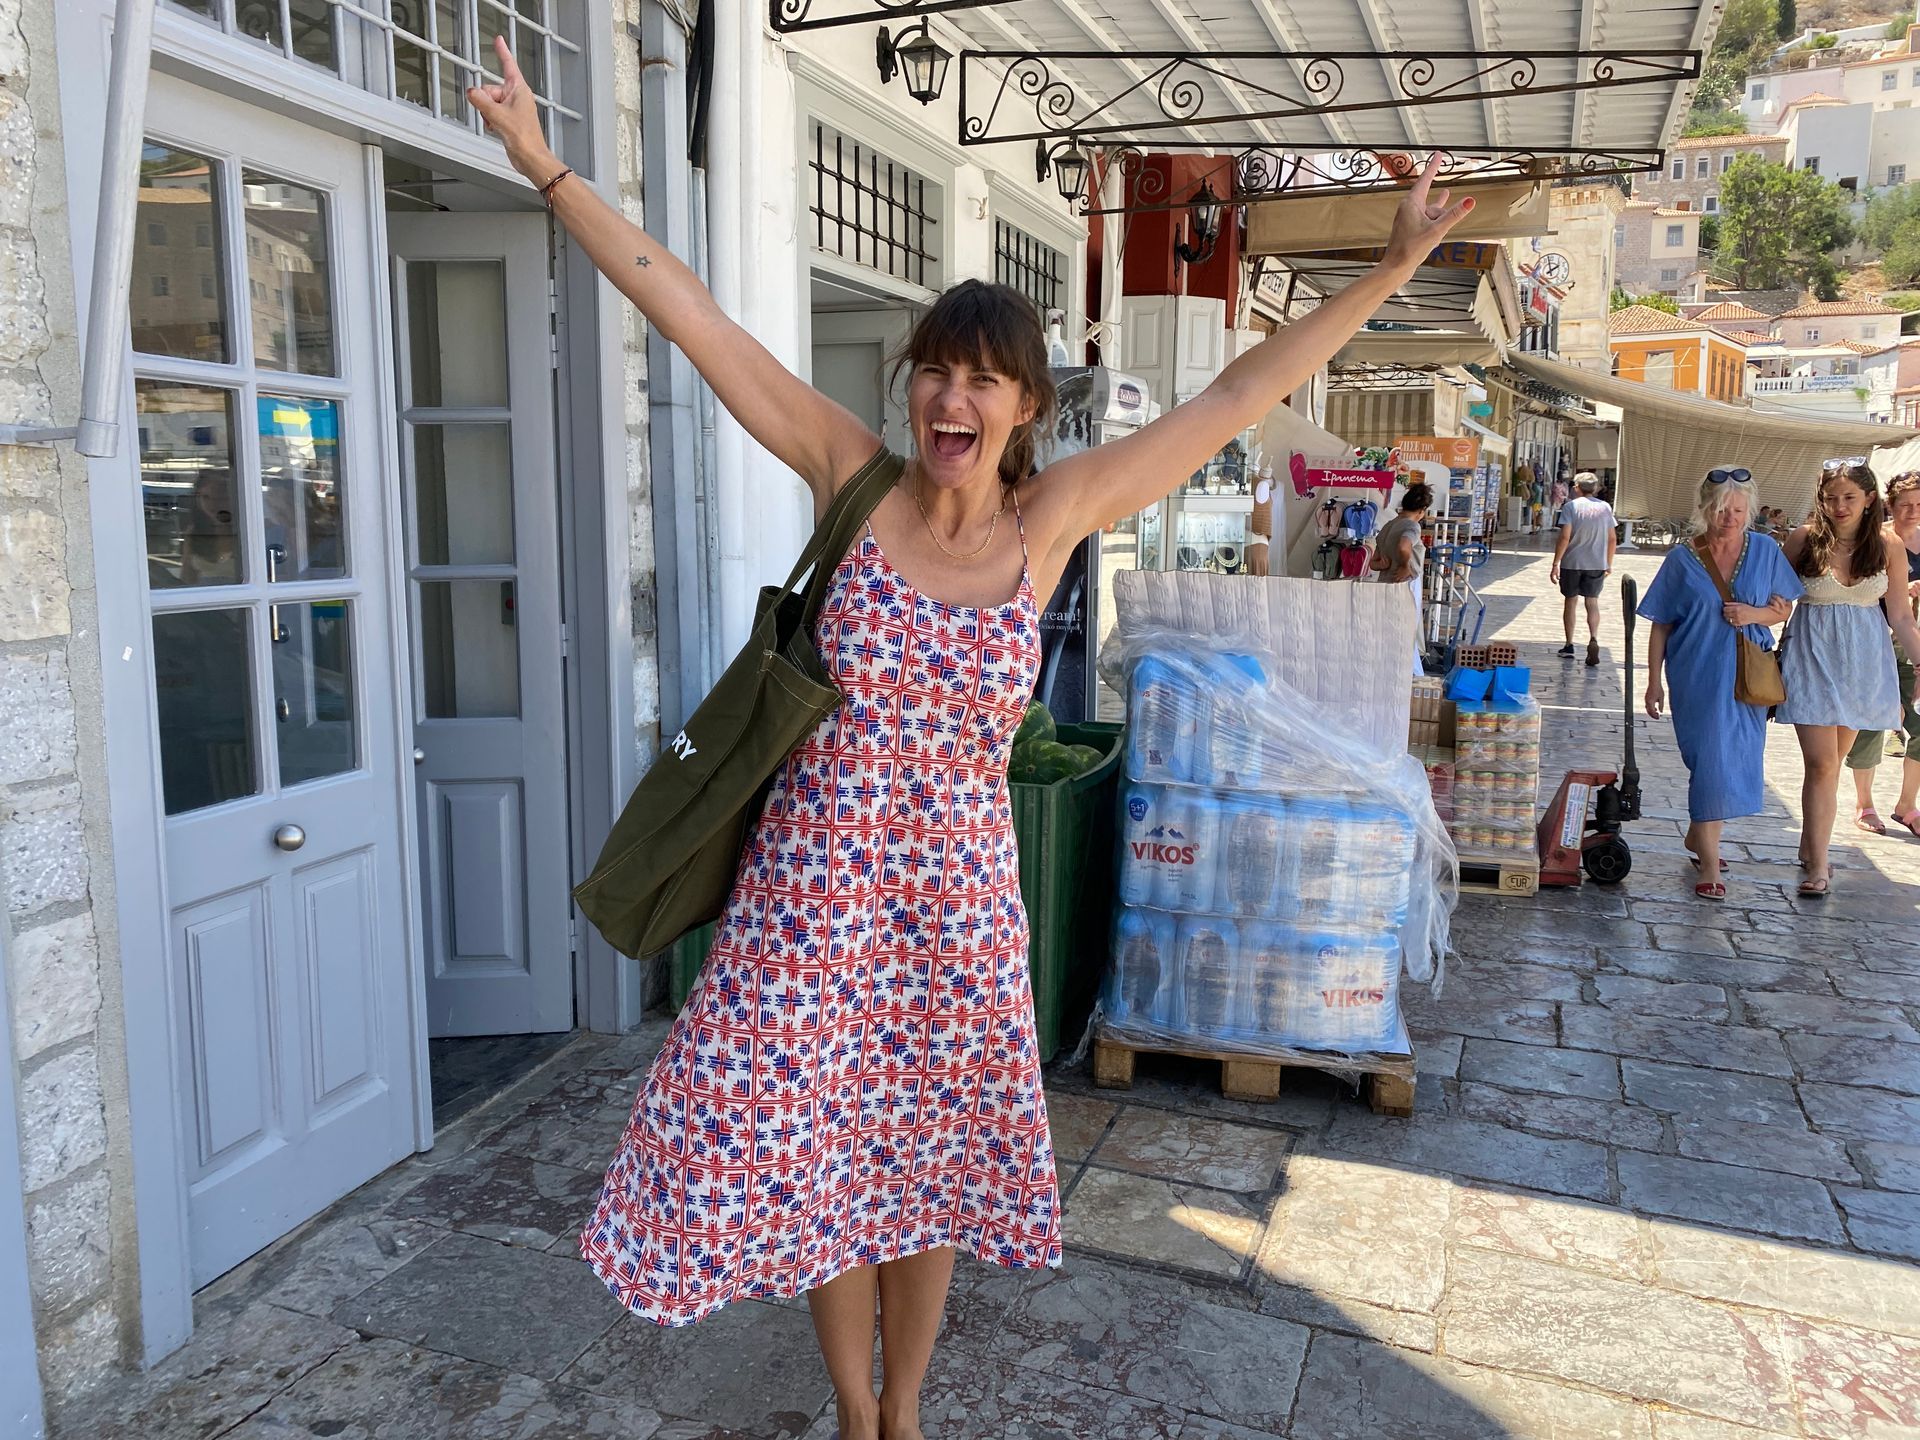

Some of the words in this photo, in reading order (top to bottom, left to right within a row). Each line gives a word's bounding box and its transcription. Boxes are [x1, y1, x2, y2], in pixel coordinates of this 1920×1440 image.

[1430, 242, 1489, 264] KET
[1402, 452, 1426, 462] ΠΟΧΗ
[1321, 470, 1378, 486] Ipanema
[1043, 608, 1080, 621] ream!
[671, 729, 698, 761] RY
[1130, 803, 1145, 812] 5+1
[1131, 842, 1195, 865] VIKOS
[1510, 877, 1528, 888] EUR
[1321, 988, 1384, 1009] VIKOS
